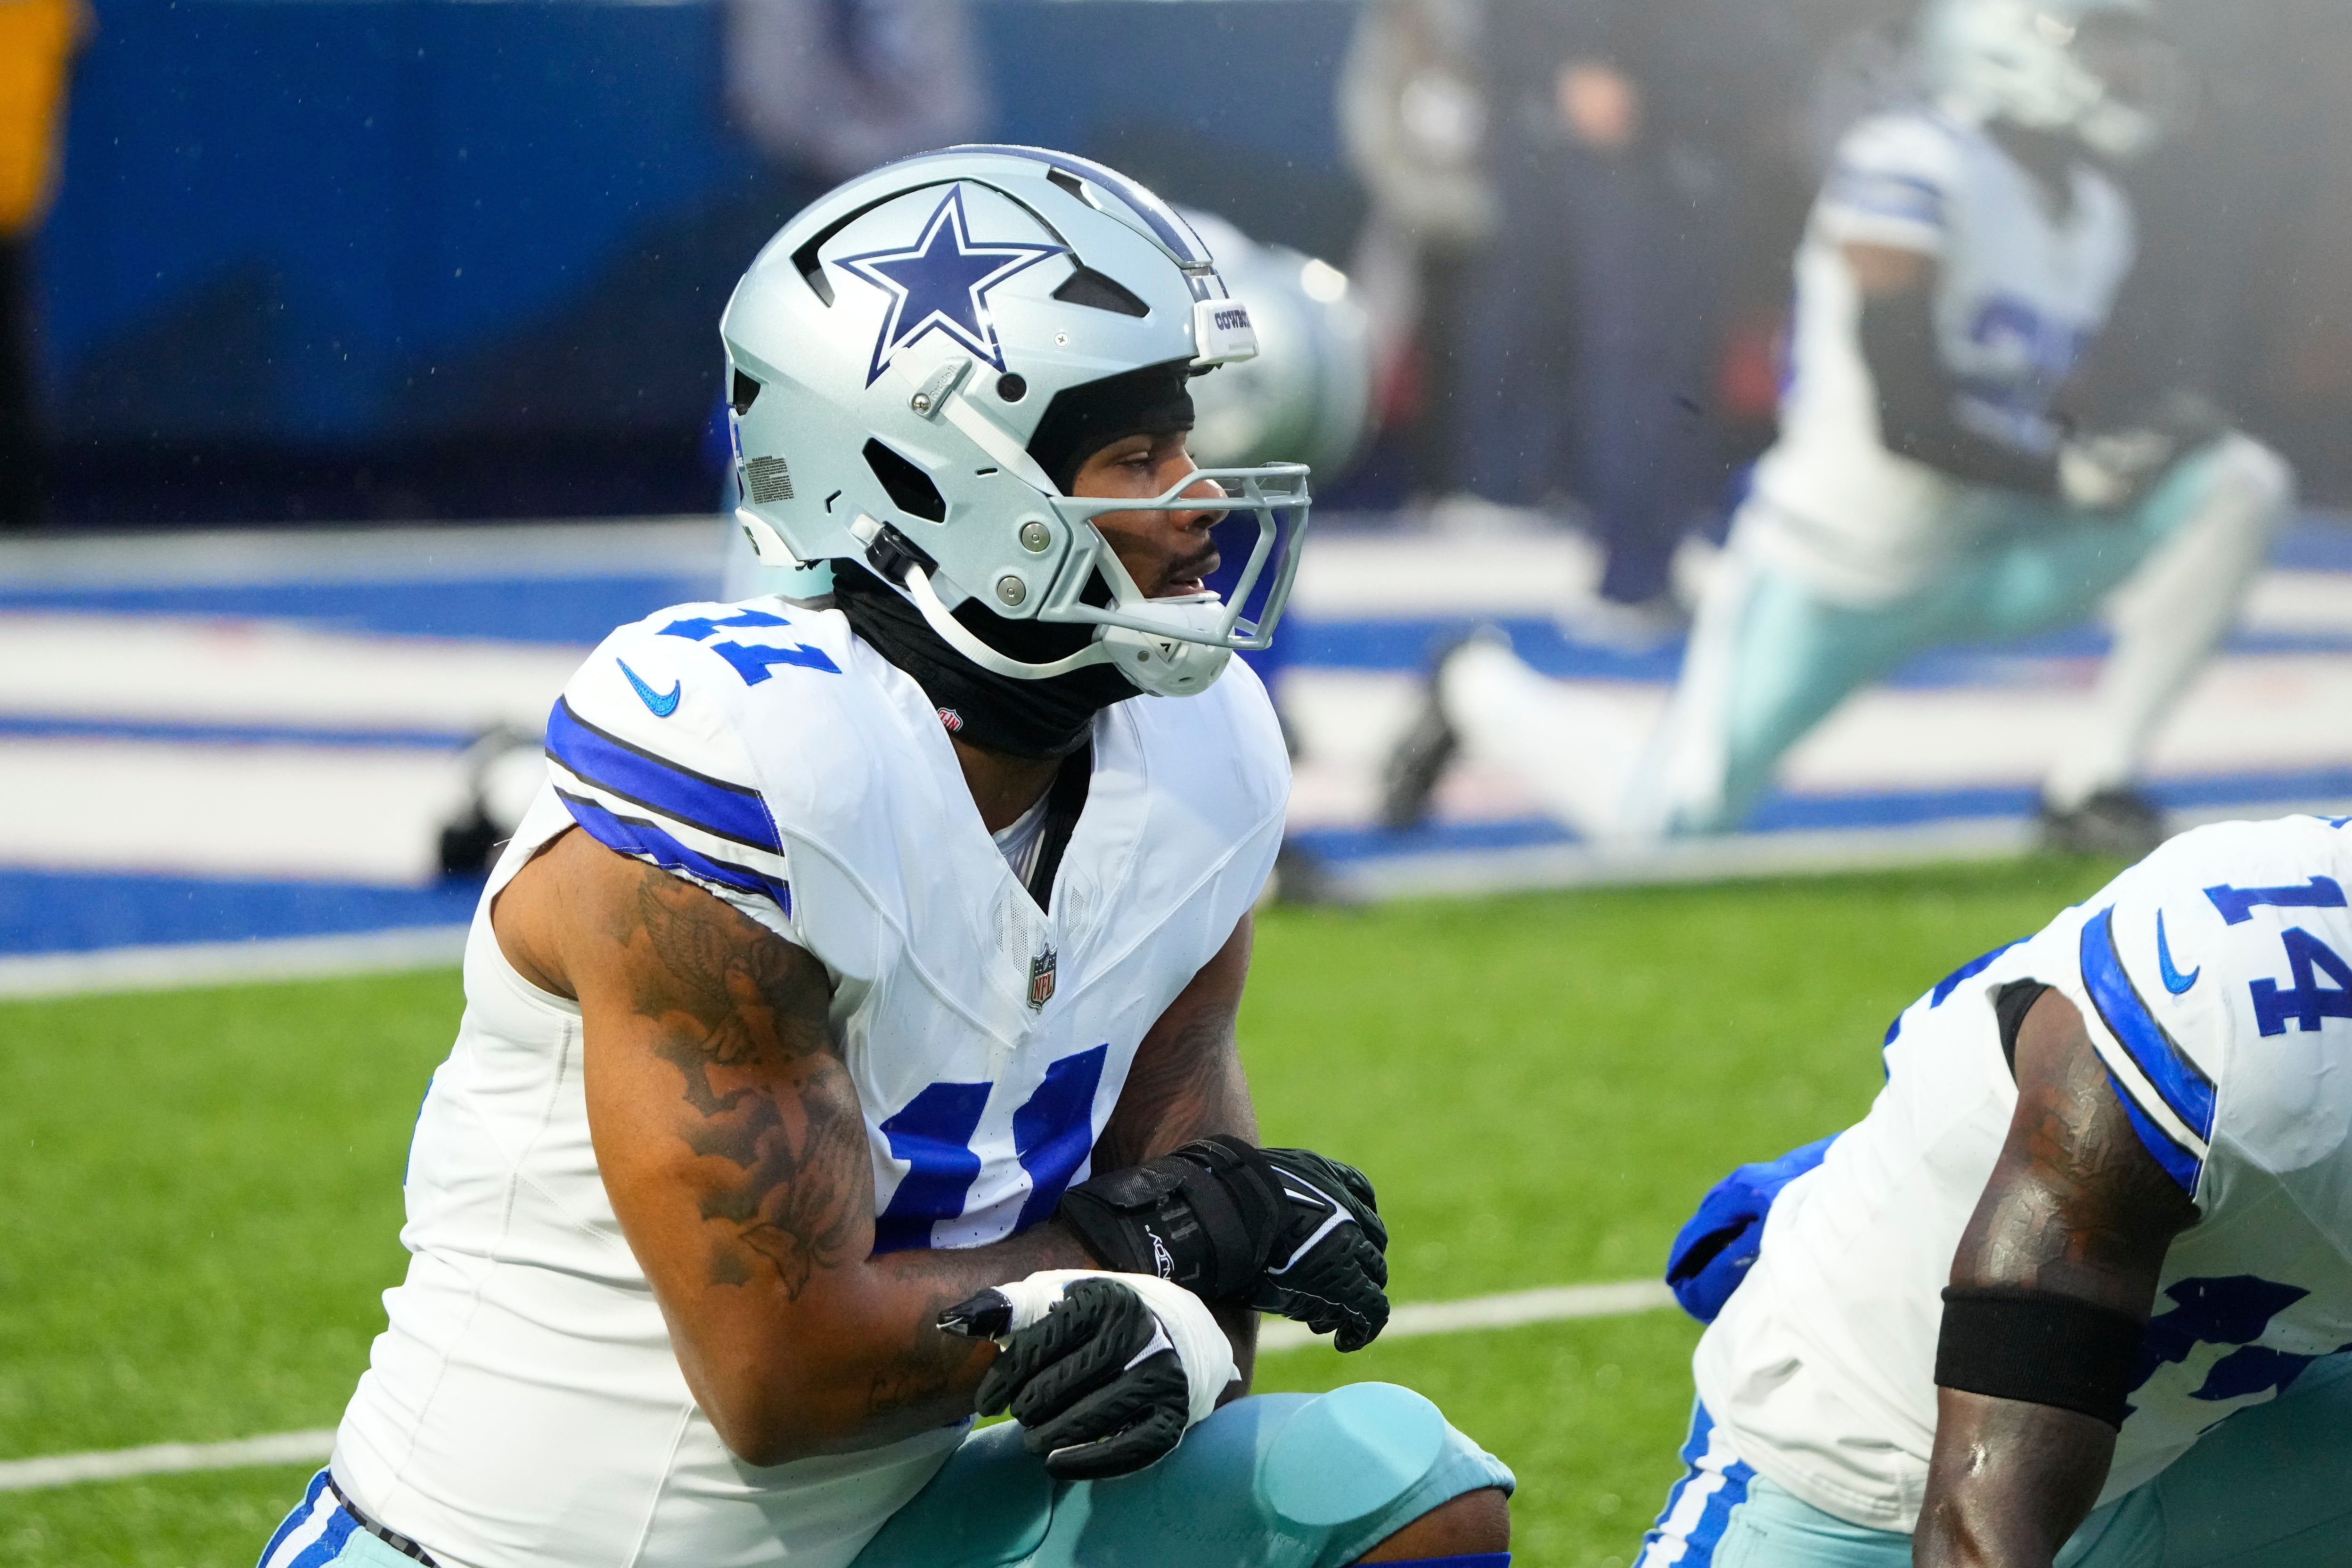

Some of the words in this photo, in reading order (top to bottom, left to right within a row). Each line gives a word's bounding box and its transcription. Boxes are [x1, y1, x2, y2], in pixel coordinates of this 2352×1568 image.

[1215, 309, 1251, 330] COWBO
[929, 365, 957, 401] Riddell
[654, 608, 842, 686] 11
[939, 711, 960, 731] NFL
[2202, 874, 2352, 1037] 14
[1033, 972, 1053, 1001] NFL
[871, 1043, 1110, 1256] 11
